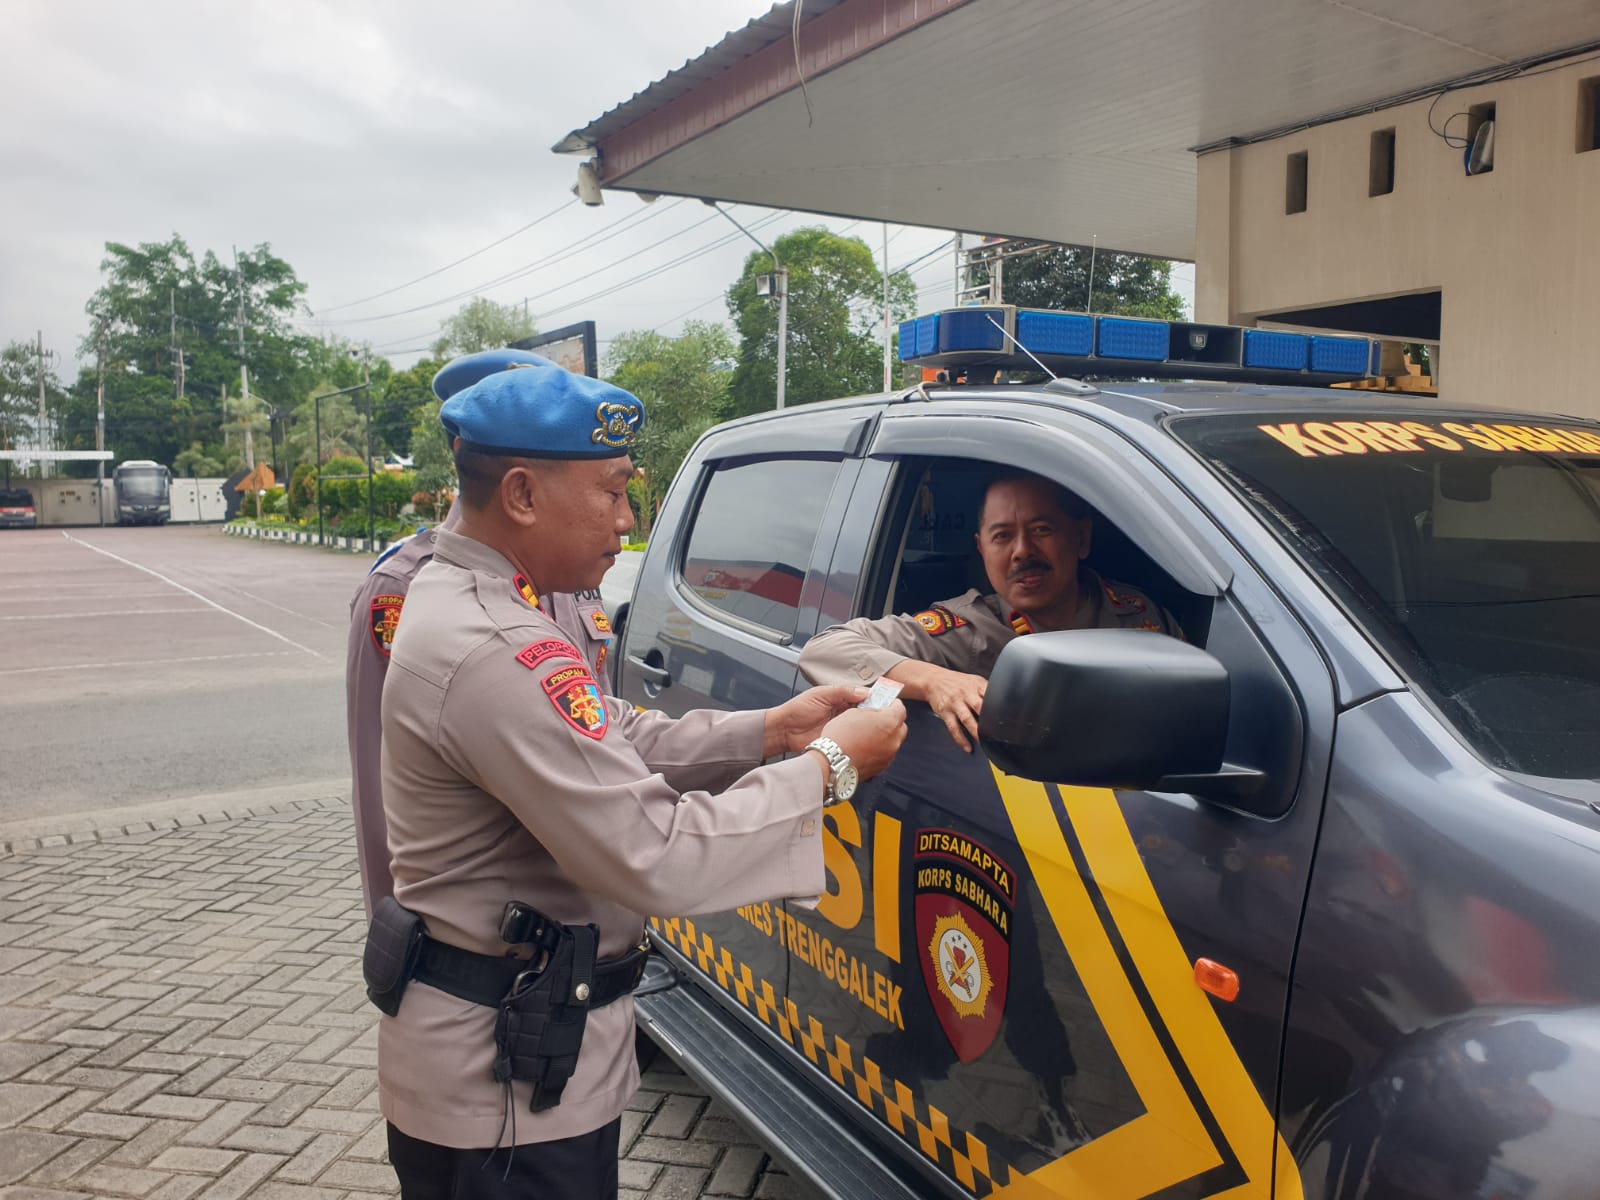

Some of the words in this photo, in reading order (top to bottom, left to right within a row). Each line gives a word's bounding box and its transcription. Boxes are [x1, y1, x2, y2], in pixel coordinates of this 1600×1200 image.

[1256, 421, 1464, 457] KORPS
[550, 668, 585, 685] PROPAM
[919, 834, 1010, 895] DITSAMAPTA
[917, 868, 952, 889] KORPS
[954, 873, 1008, 936] SABHARA
[774, 905, 905, 1031] TRENGGALEK
